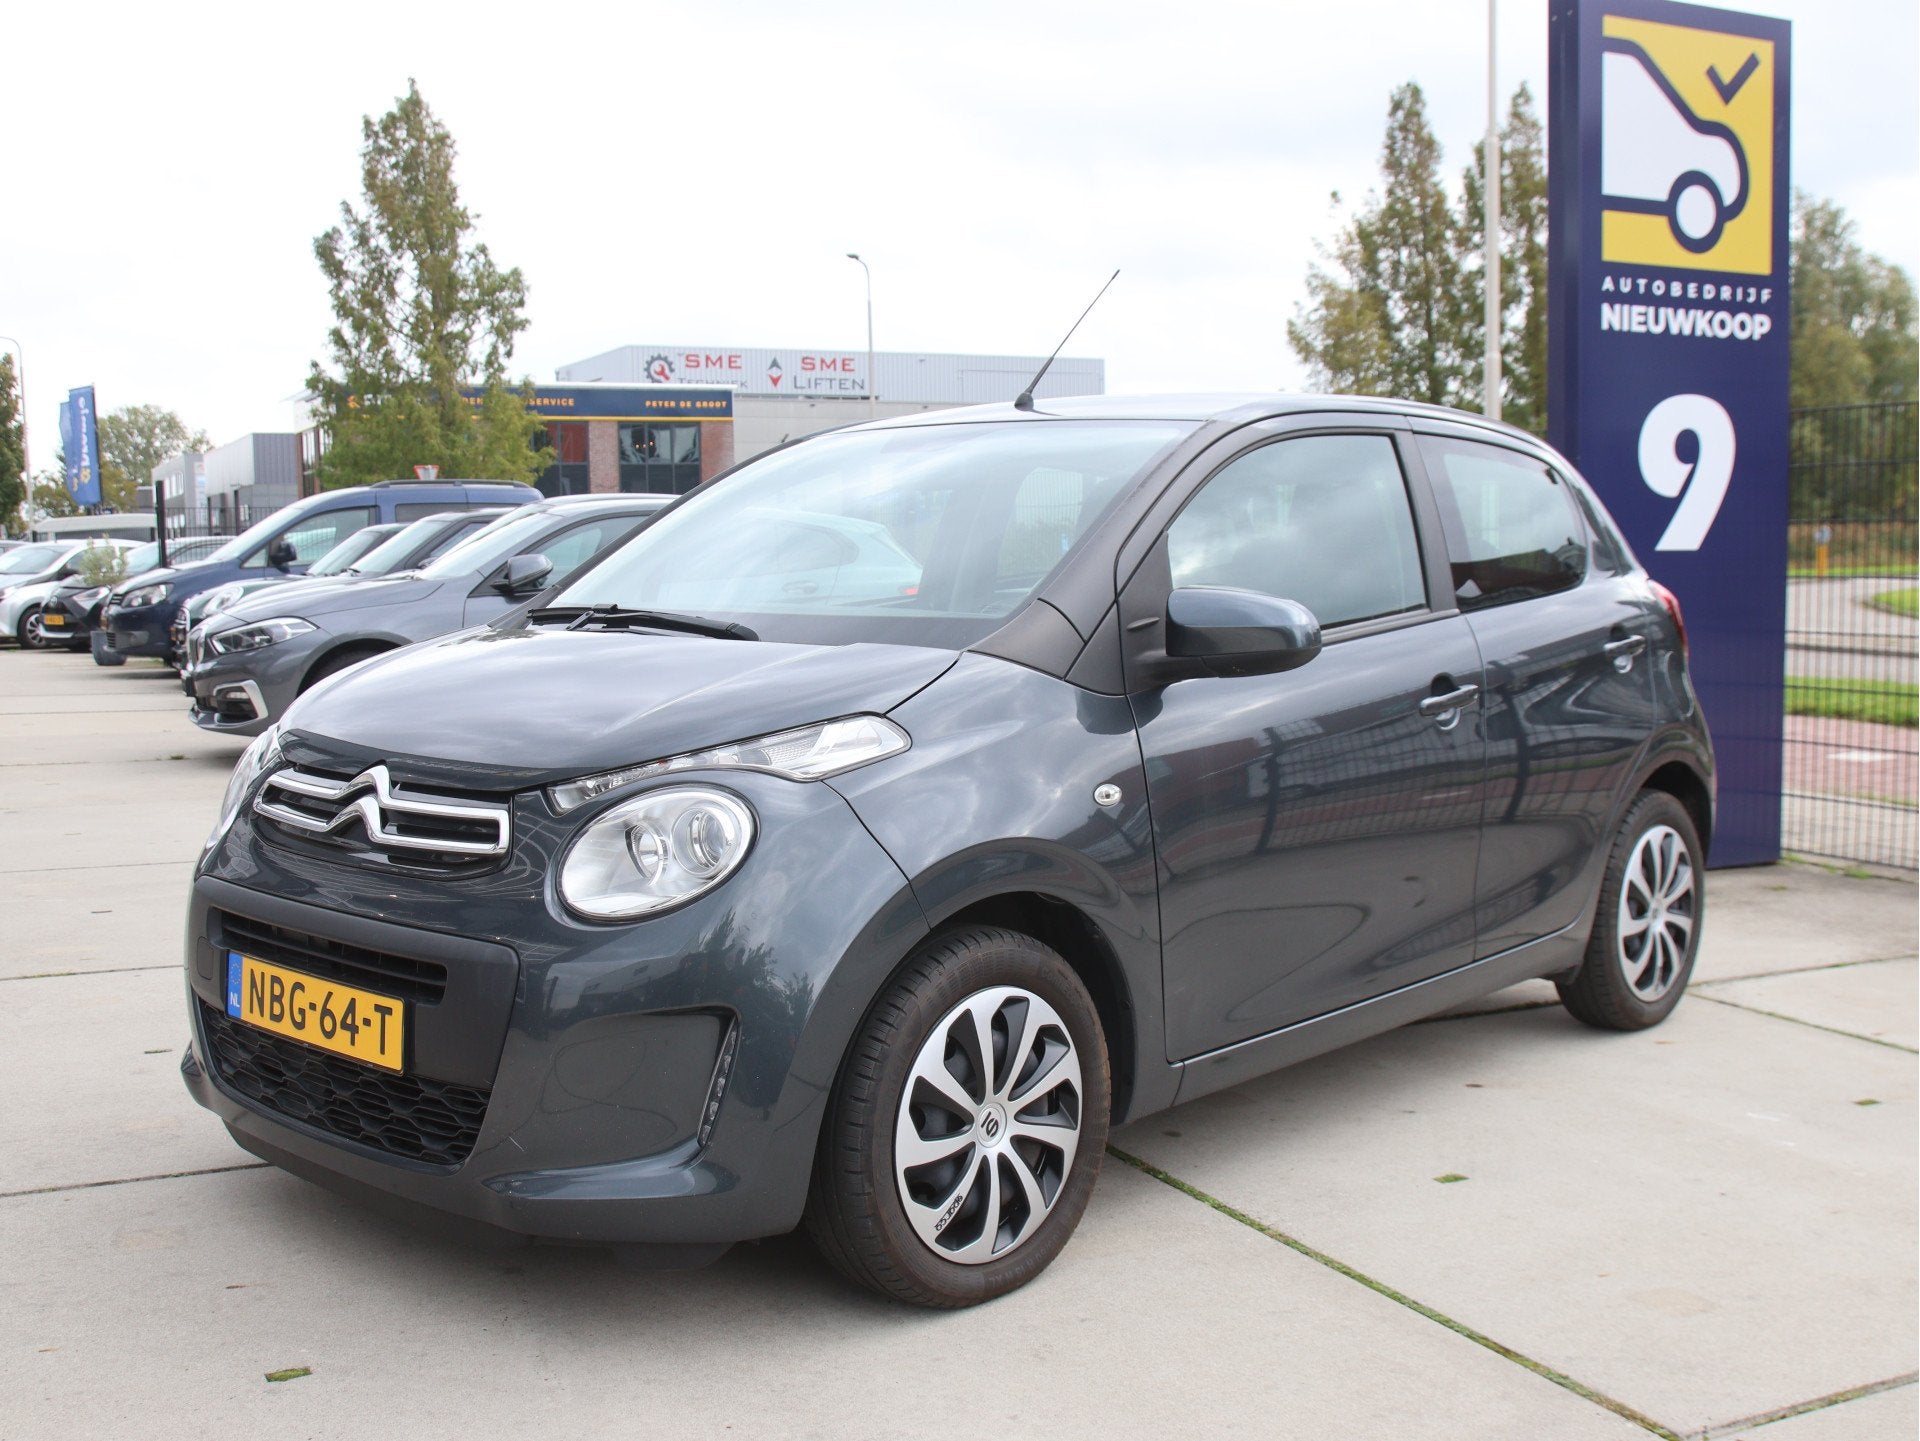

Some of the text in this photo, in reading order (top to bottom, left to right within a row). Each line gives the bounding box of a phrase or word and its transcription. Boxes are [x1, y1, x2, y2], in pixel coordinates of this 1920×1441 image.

[1601, 275, 1773, 304] AUTOBEDRIJF
[1600, 302, 1772, 341] NIEUWKOOP
[685, 353, 742, 369] SME
[801, 356, 855, 372] SME
[793, 375, 865, 390] LIFTEN
[645, 400, 727, 409] PETER DE GROOT
[1637, 393, 1736, 551] 9
[230, 991, 241, 1008] NL
[249, 967, 393, 1056] NBG-64-T
